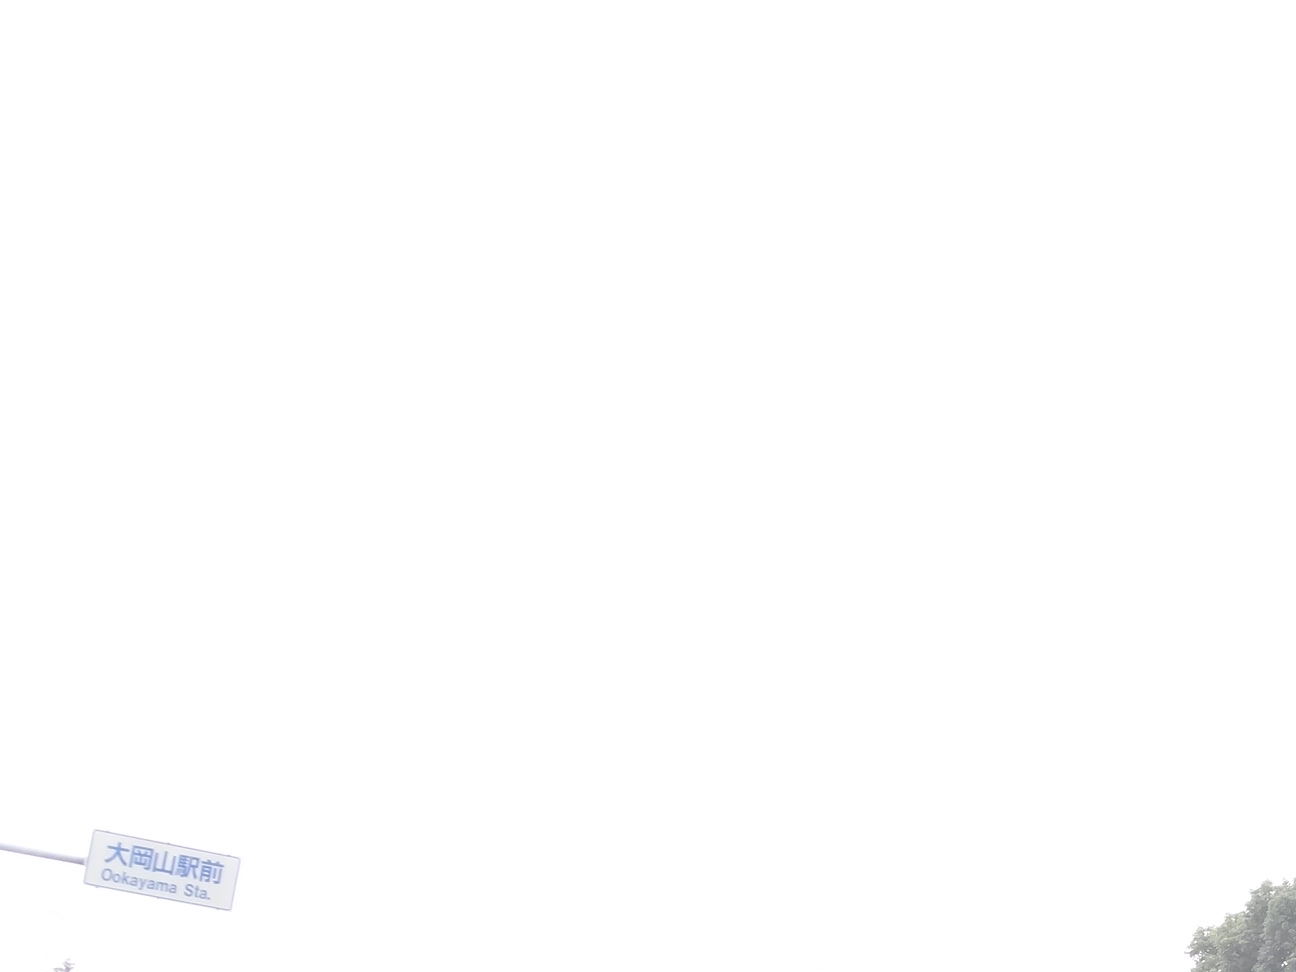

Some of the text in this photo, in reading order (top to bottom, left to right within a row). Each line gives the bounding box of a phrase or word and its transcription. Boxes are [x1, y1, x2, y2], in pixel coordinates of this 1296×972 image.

[104, 842, 225, 884] 大岡山駅前
[101, 868, 211, 900] Ookayama Sta.
